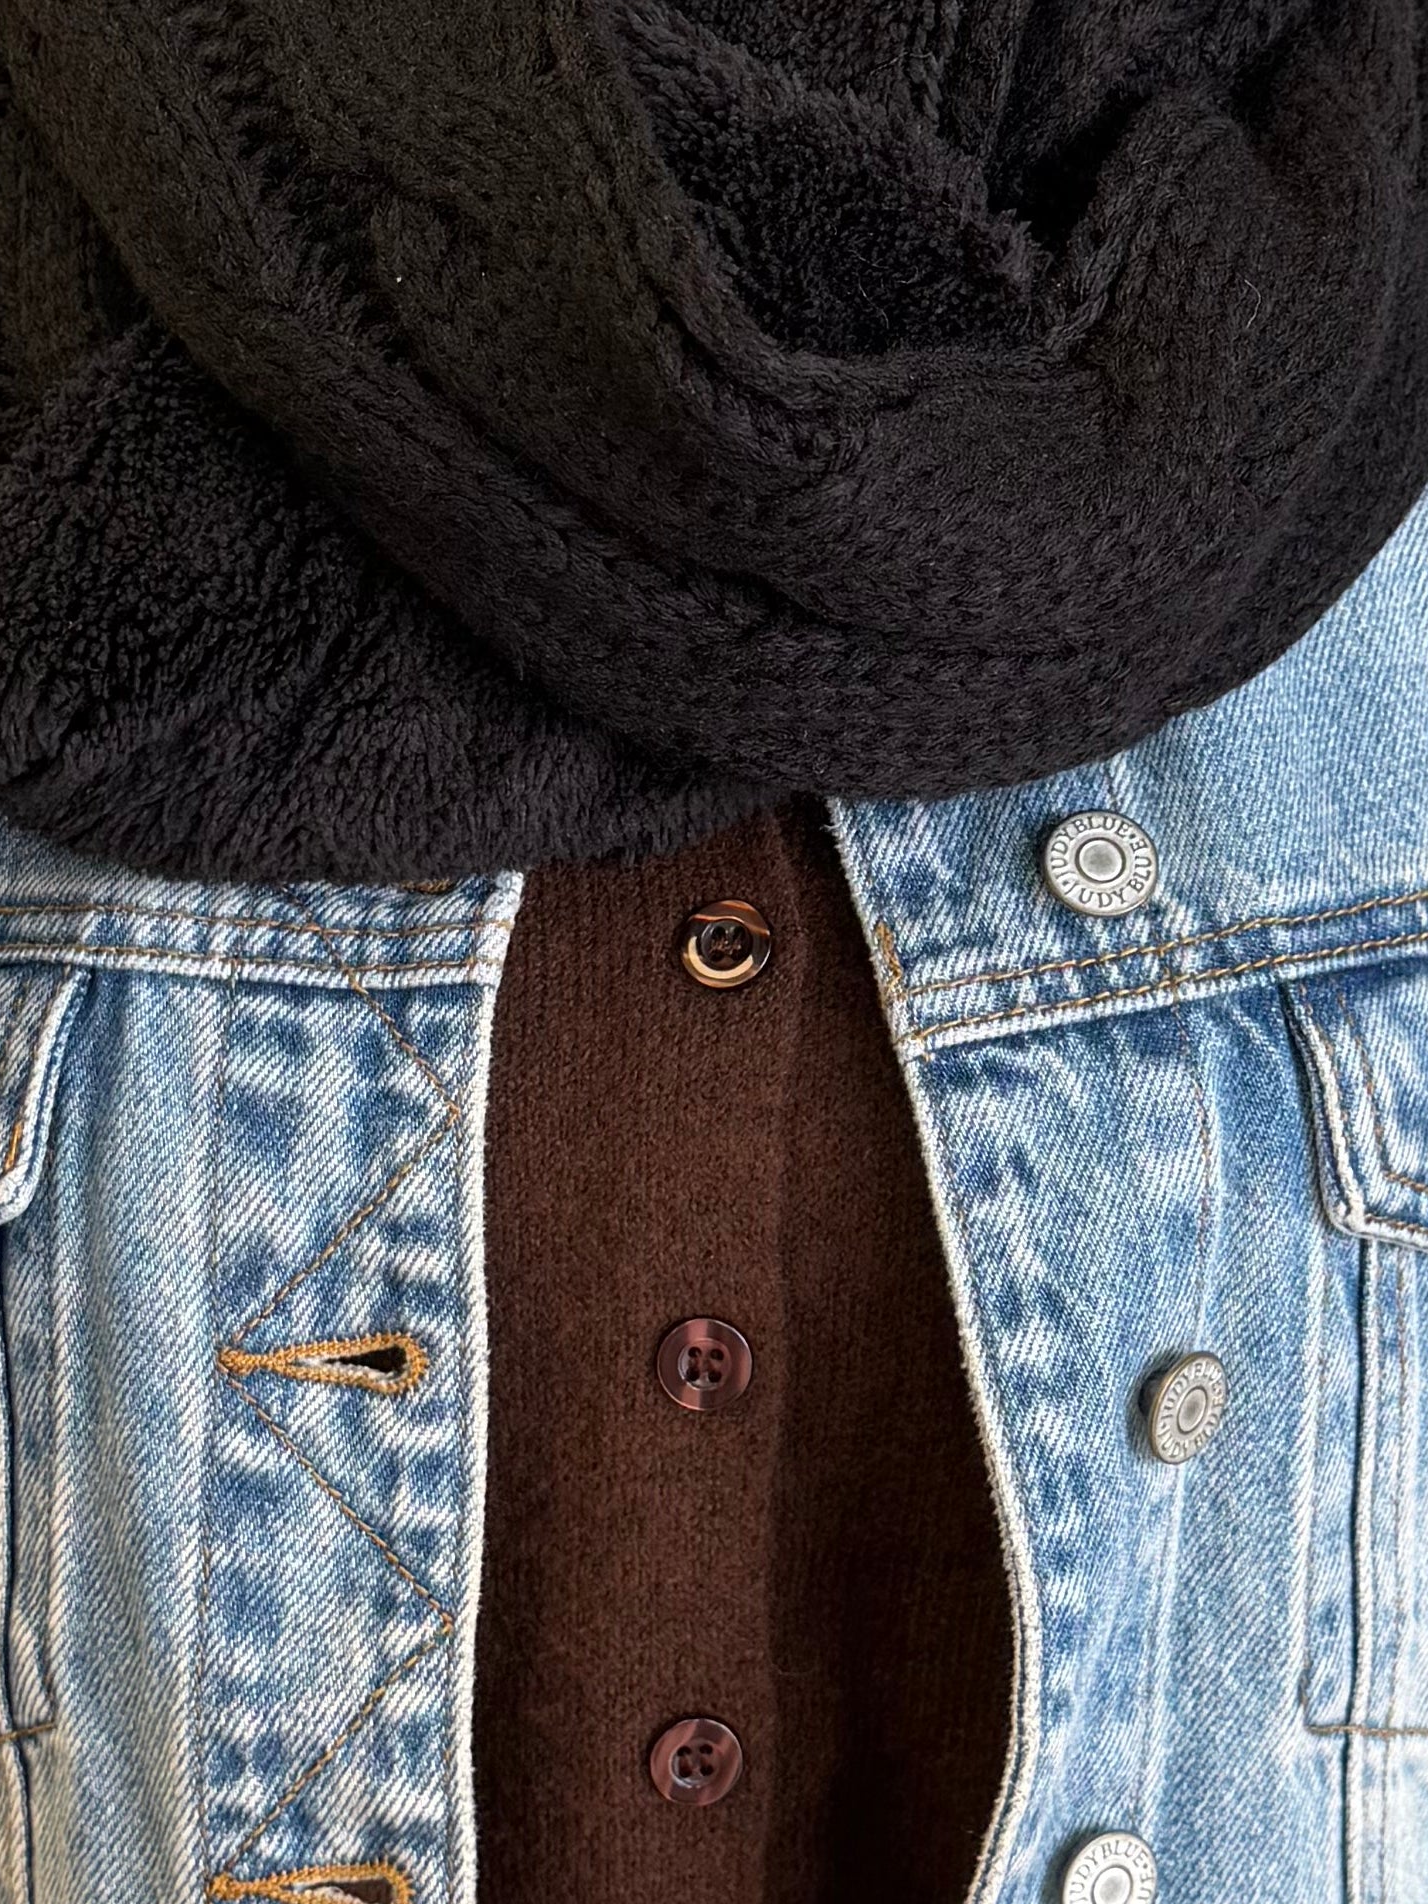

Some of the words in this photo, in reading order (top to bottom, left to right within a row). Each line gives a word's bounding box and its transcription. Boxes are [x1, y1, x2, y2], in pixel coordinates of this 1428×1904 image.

[1051, 826, 1076, 880] JUDY
[1072, 816, 1134, 838] BLUE
[1064, 881, 1127, 908] JUDY
[1127, 838, 1153, 893] BLUE
[1069, 1850, 1099, 1904] JUDY
[1100, 1839, 1148, 1868] BLUE
